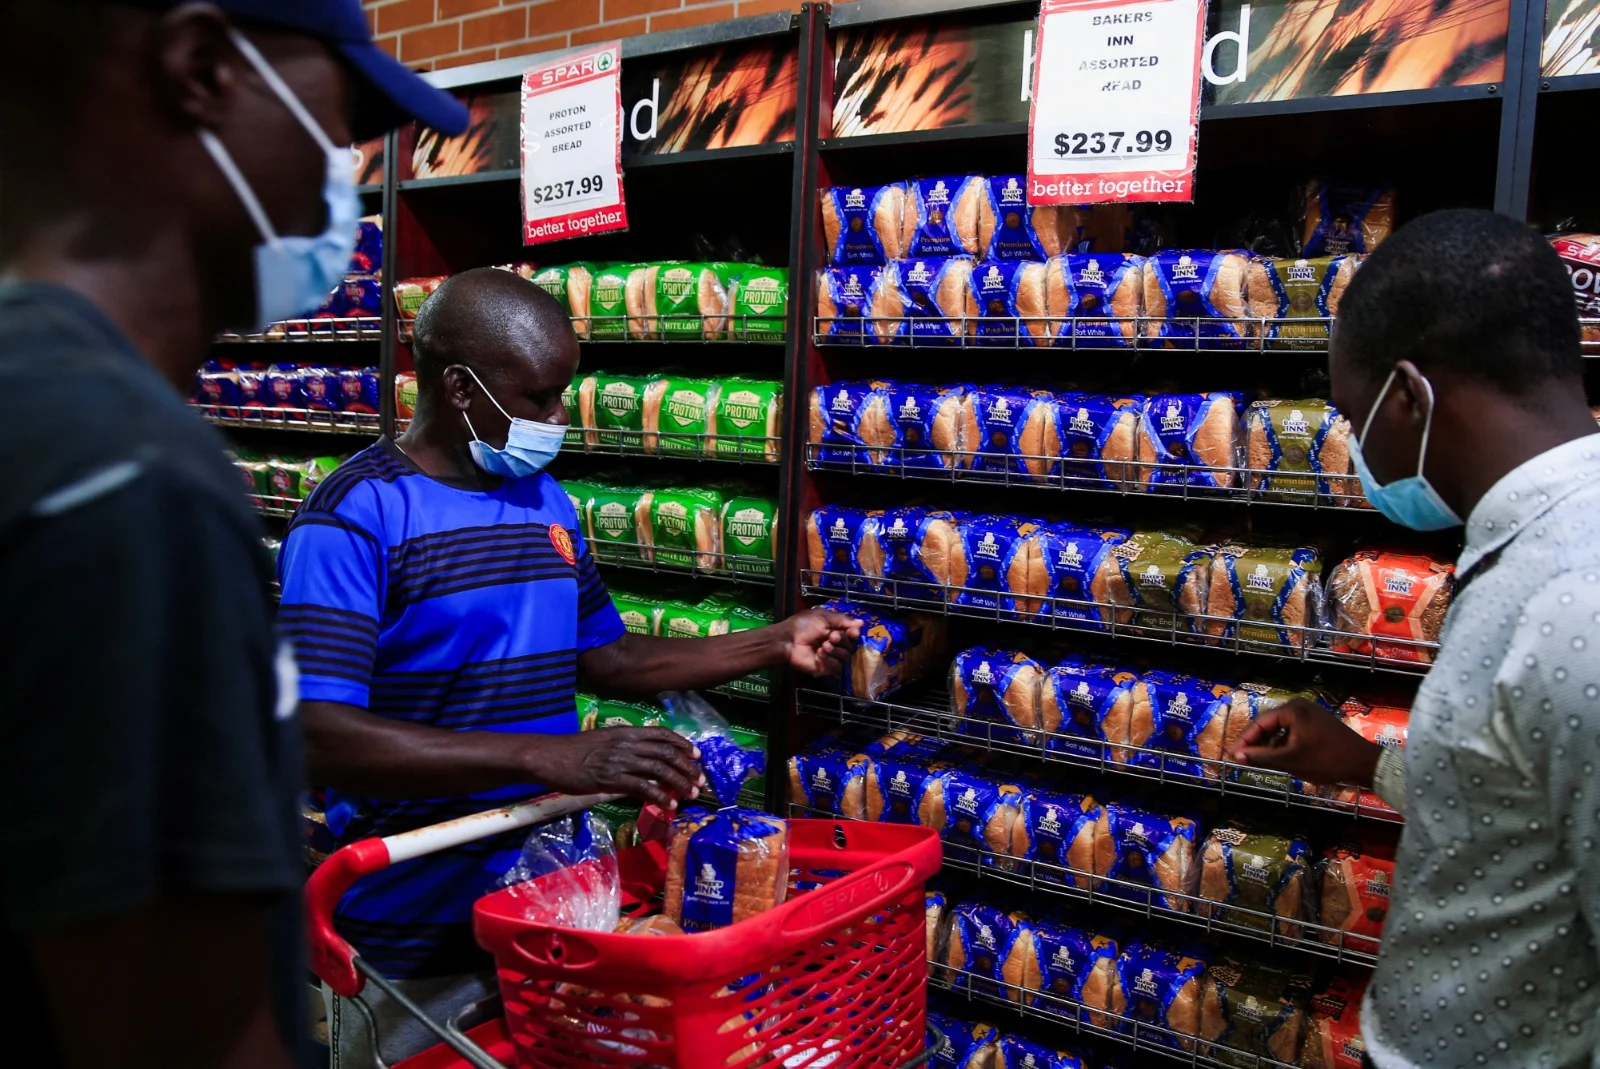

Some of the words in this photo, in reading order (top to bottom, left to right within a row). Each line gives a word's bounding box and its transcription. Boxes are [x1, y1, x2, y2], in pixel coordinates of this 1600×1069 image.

[1092, 11, 1153, 27] BAKERS
[1107, 35, 1134, 47] INN
[1078, 55, 1159, 72] ASSORTED
[541, 58, 595, 85] SPAR
[549, 105, 586, 121] PROTON
[544, 120, 592, 139] ASSORTED
[552, 139, 583, 154] BREAD
[1054, 129, 1172, 158] $237.99
[533, 174, 603, 206] $237.99
[1032, 179, 1092, 198] better
[1099, 175, 1186, 198] together
[527, 217, 565, 240] better
[567, 210, 622, 235] together
[1292, 271, 1312, 279] INN
[744, 291, 777, 304] PROTON
[682, 321, 700, 330] LOAF
[1282, 325, 1323, 333] Premium
[603, 395, 633, 409] PROTON
[668, 402, 701, 420] PROTON
[725, 406, 758, 420] PROTON
[1286, 424, 1306, 433] INN
[600, 516, 628, 530] PROTON
[731, 522, 763, 537] PROTON
[1143, 578, 1163, 587] INN
[1251, 578, 1272, 589] INN
[1388, 584, 1408, 593] INN
[697, 883, 719, 895] INN
